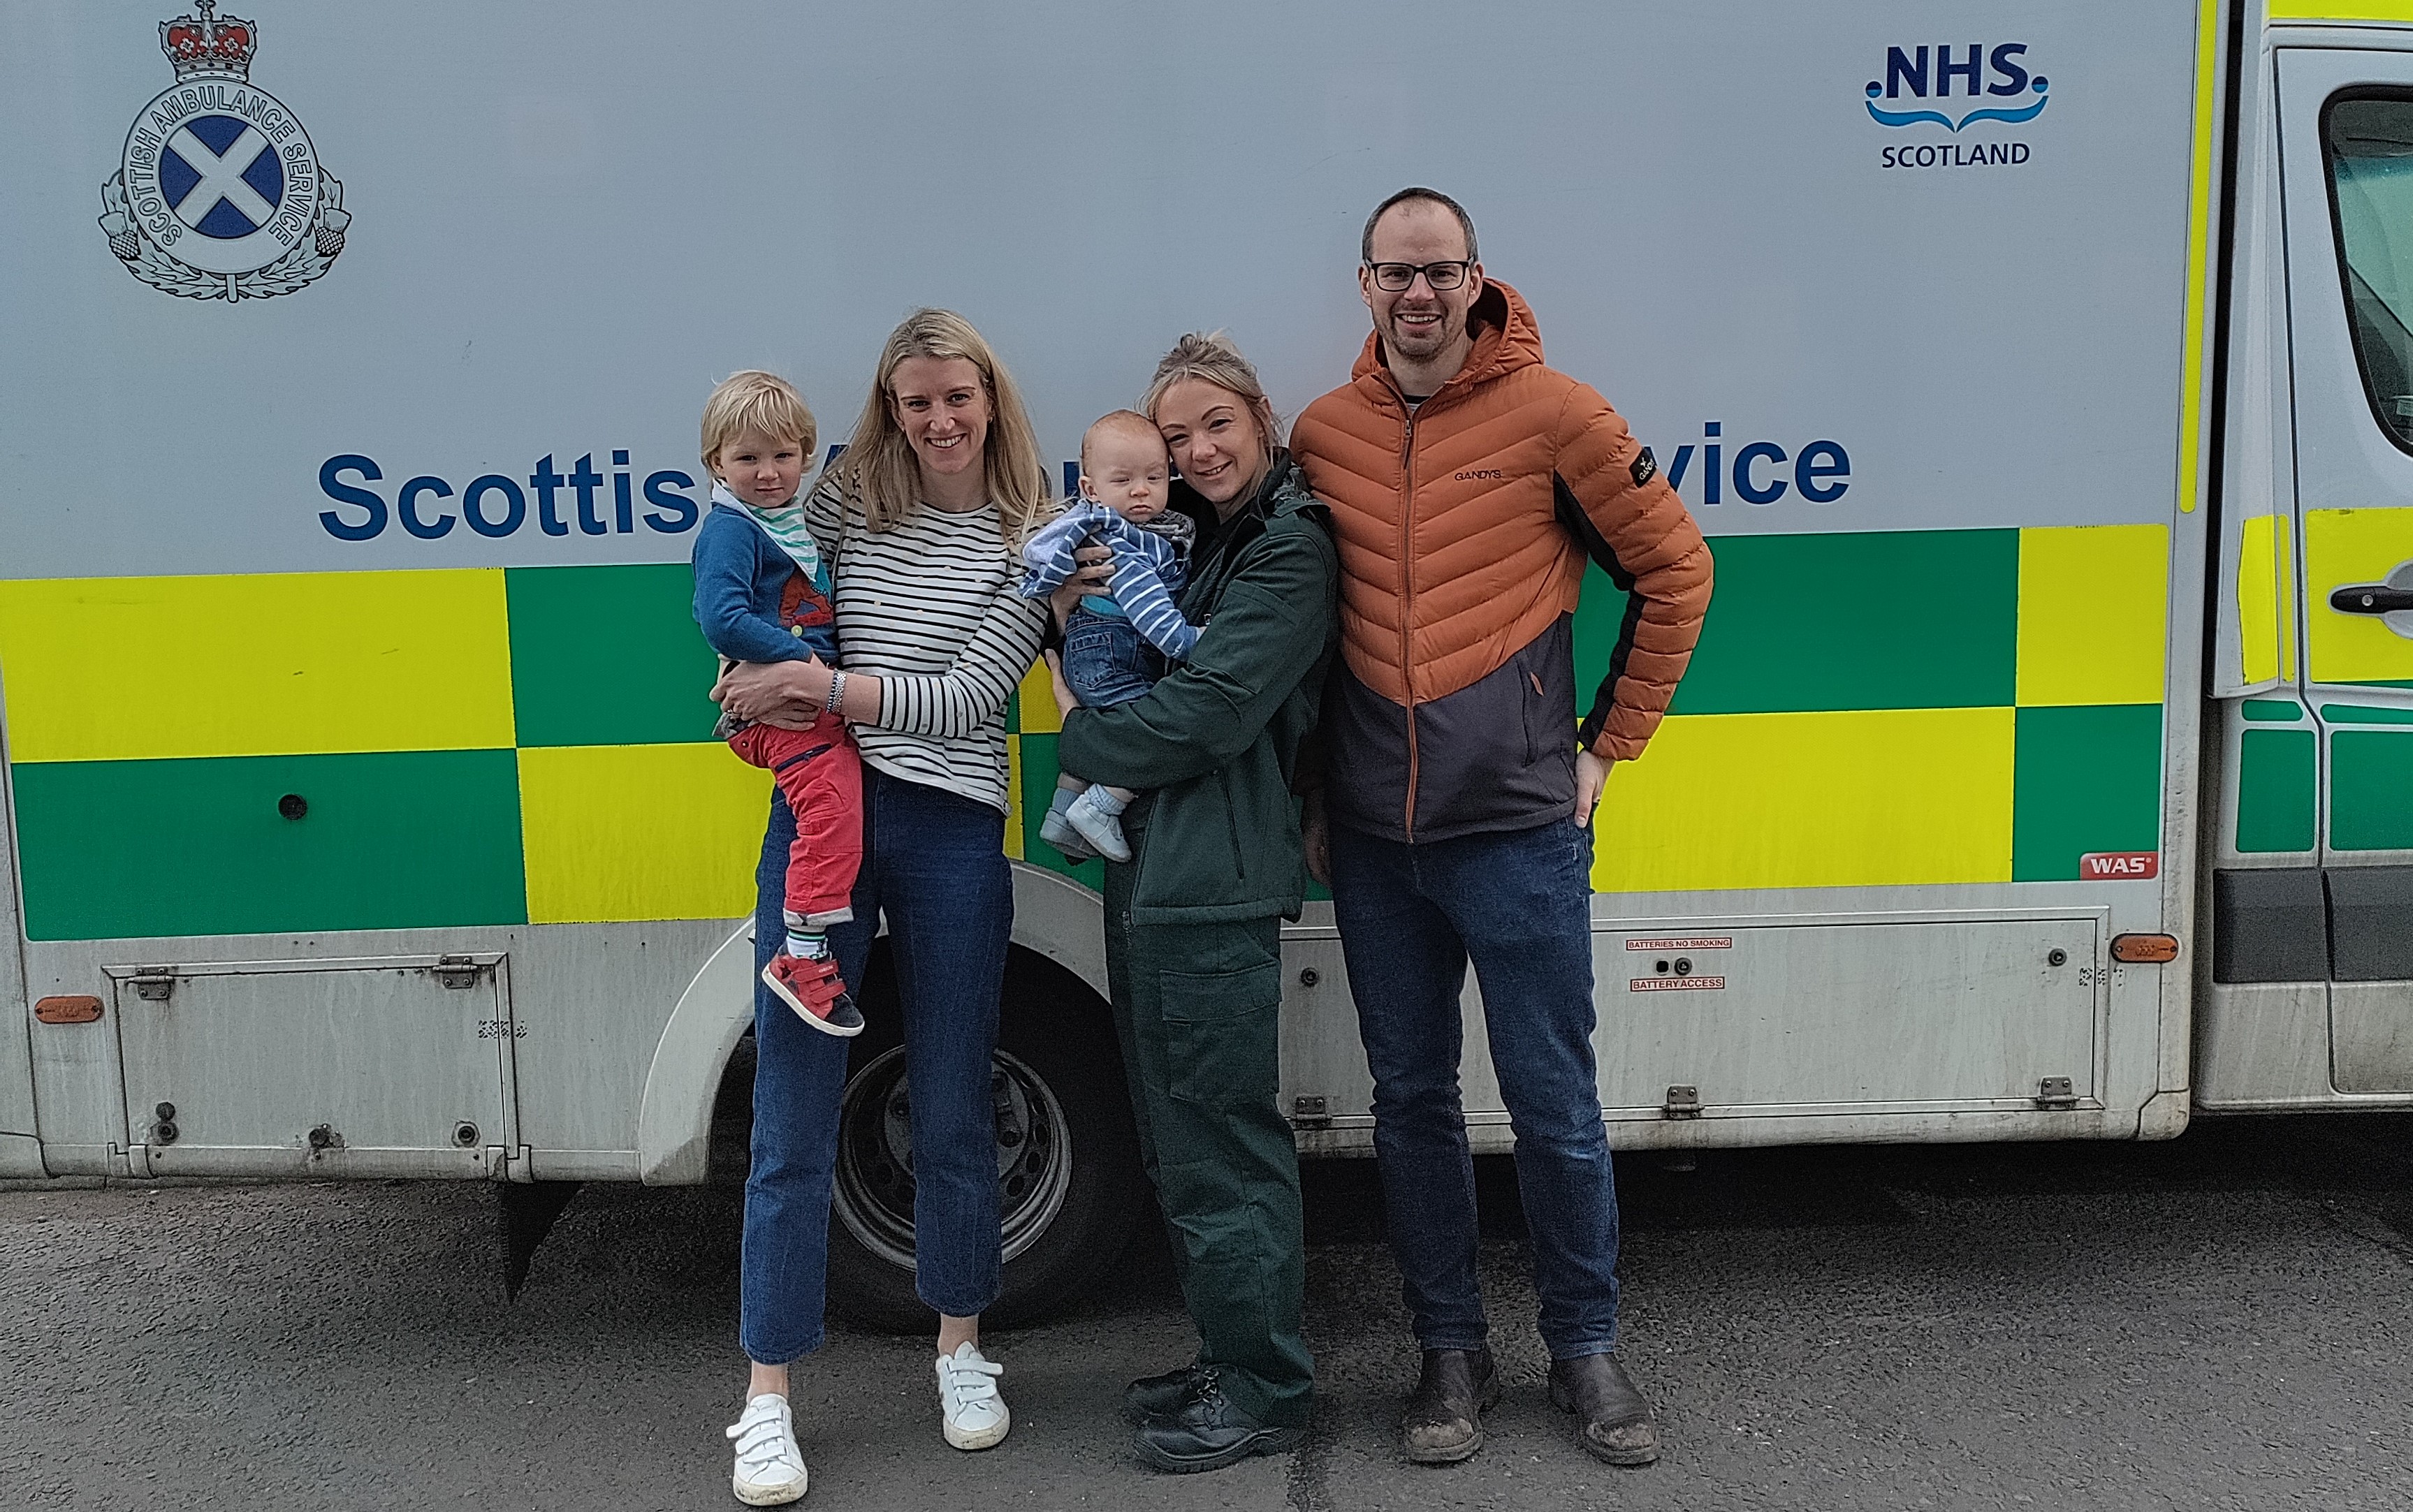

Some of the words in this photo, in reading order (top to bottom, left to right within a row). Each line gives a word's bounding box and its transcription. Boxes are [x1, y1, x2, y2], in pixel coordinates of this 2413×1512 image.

[1886, 43, 2028, 98] NHS
[150, 85, 296, 144] AMBULANCE
[1882, 142, 2030, 168] SCOTLAND
[130, 128, 182, 247] SCOTTISH
[268, 142, 314, 245] SERVICE
[318, 449, 699, 541] Scottis
[1455, 469, 1501, 481] GANDYS
[1633, 980, 1679, 989] BATTERY
[1680, 978, 1722, 988] ACCESS
